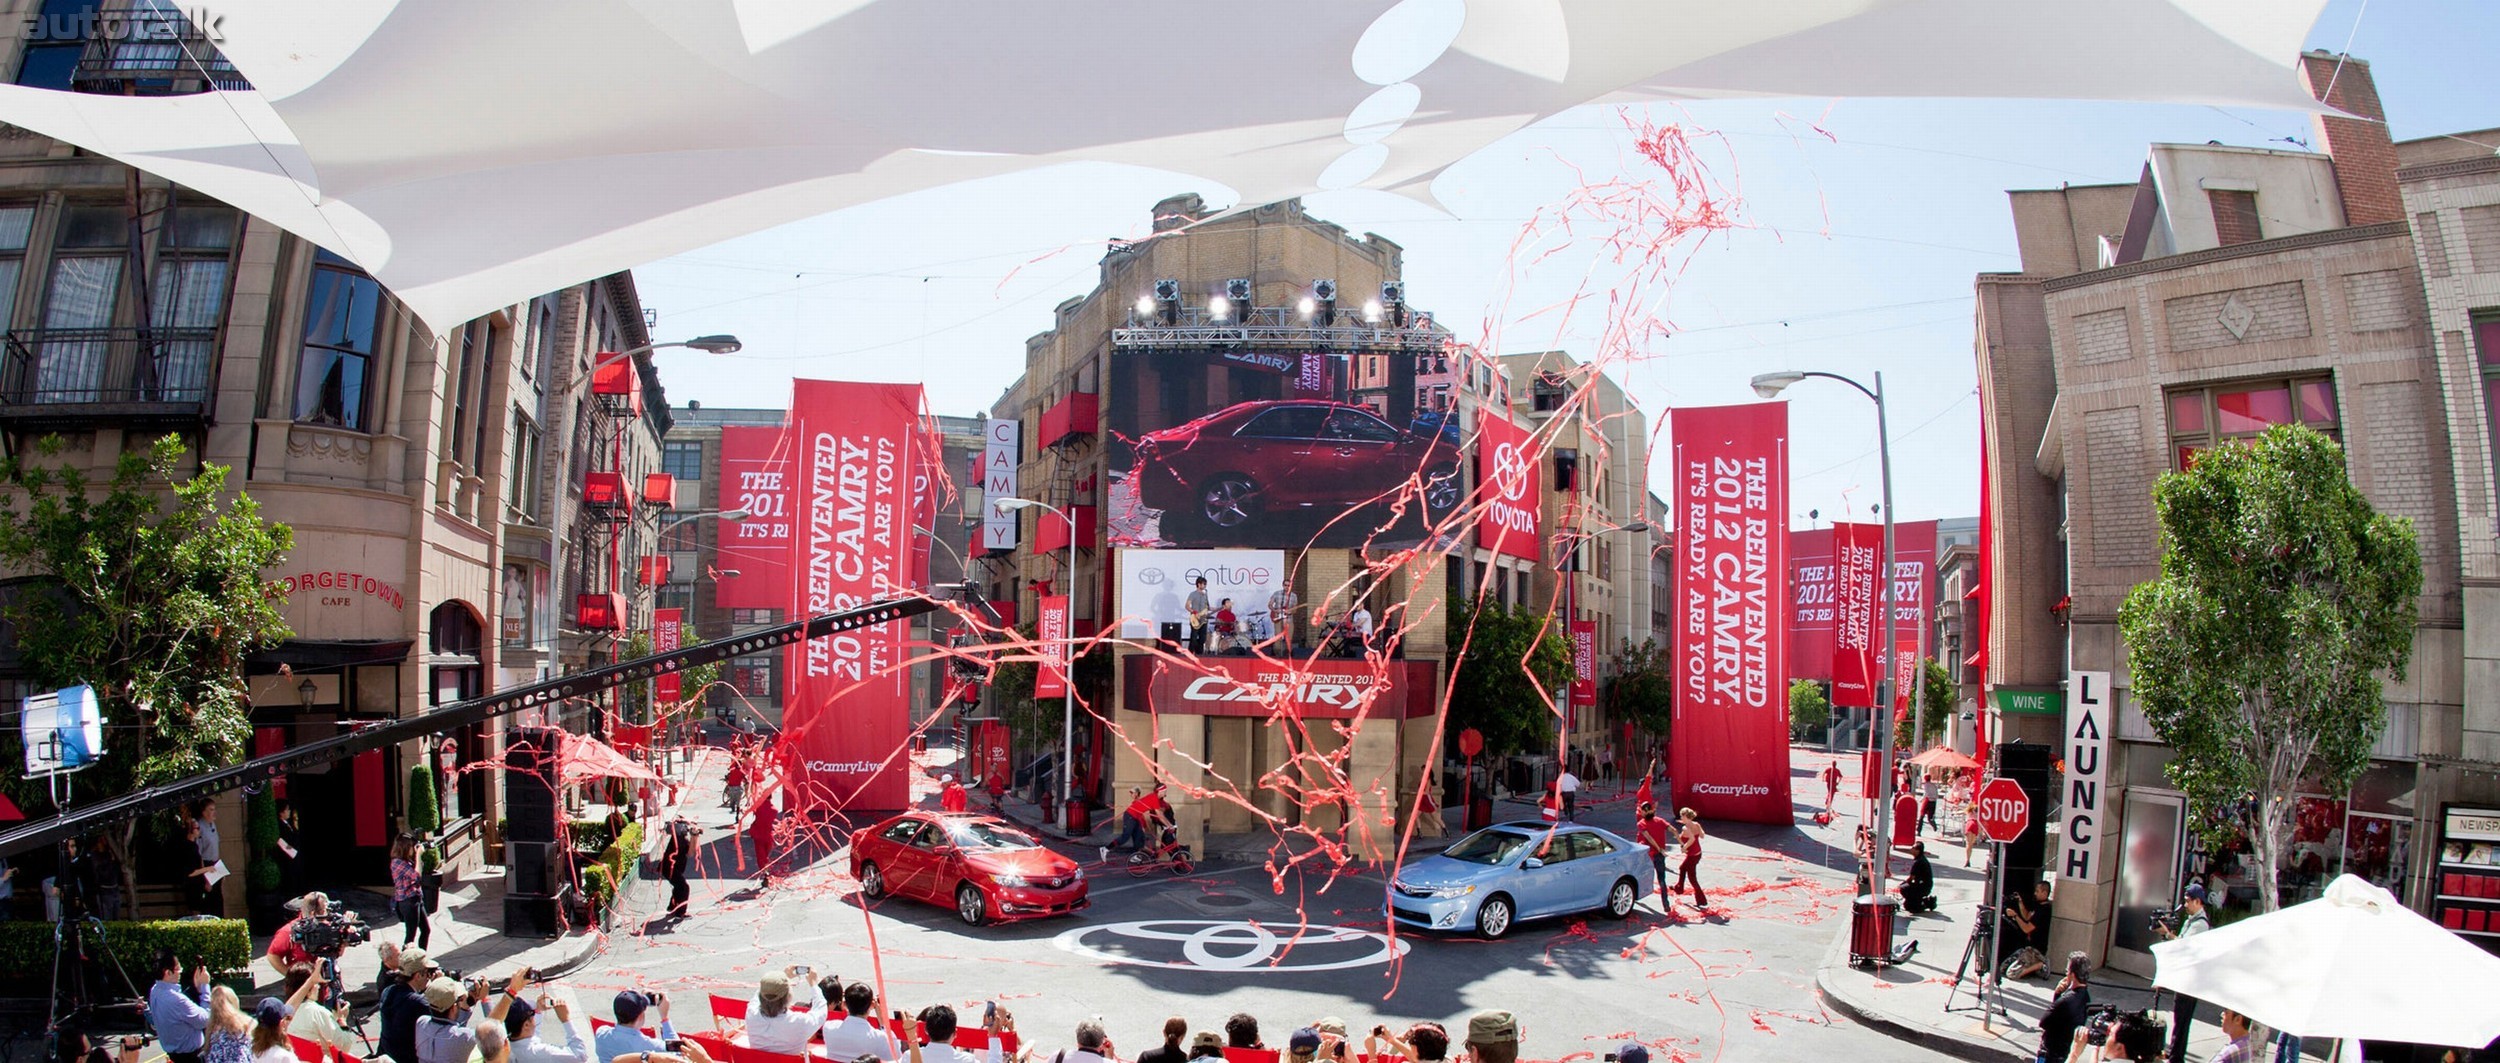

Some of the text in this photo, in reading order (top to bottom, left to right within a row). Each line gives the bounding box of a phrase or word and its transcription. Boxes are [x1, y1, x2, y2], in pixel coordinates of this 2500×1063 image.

[1224, 353, 1293, 371] AMRY
[741, 472, 783, 490] THE
[876, 437, 895, 496] YOU?
[740, 493, 790, 517] 201
[1490, 500, 1534, 534] TOYOTA
[739, 523, 769, 538] IT'S
[808, 433, 836, 617] REINVENTED
[874, 501, 892, 548] ARE
[833, 435, 870, 681] 202 CAMRY.
[1851, 546, 1863, 583] 2012
[1687, 461, 1706, 703] IT'S READY, ARE YOU?
[1713, 456, 1741, 705] 2012 CAMRY.
[1745, 457, 1767, 707] THE REINVENTED
[1800, 566, 1825, 582] THE
[1839, 601, 1847, 620] ARE
[1860, 547, 1873, 651] THE REINVENTED
[1257, 673, 1374, 685] THE RVENTED 201
[2012, 695, 2045, 710] WINE
[806, 761, 885, 775] #CamryLive
[2066, 676, 2100, 879] LAUNCH
[1692, 783, 1769, 797] #CamryLive
[1981, 798, 2025, 823] STOP
